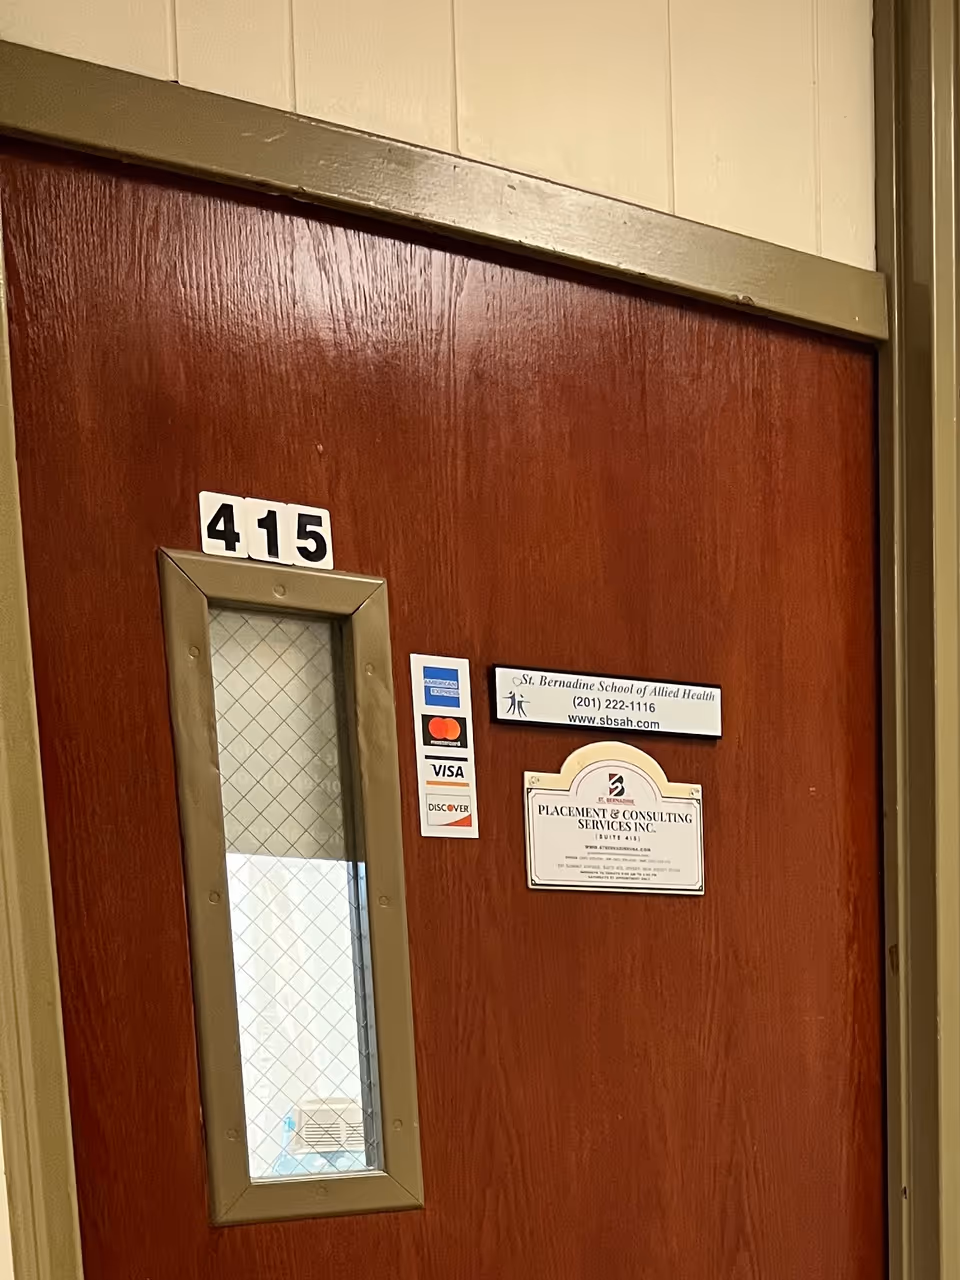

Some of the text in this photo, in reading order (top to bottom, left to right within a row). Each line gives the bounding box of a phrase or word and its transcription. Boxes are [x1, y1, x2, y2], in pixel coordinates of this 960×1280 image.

[206, 503, 327, 562] 415
[522, 673, 715, 701] St. Bernadine School of Allied Health
[573, 696, 655, 712] (201) 222-1116
[568, 714, 660, 729] www.sbsah.com
[430, 764, 464, 778] VISA
[429, 803, 469, 812] DISCOVER
[538, 805, 692, 824] PLACEMENT & CONSULTING
[578, 819, 656, 833] SERVICES INC.
